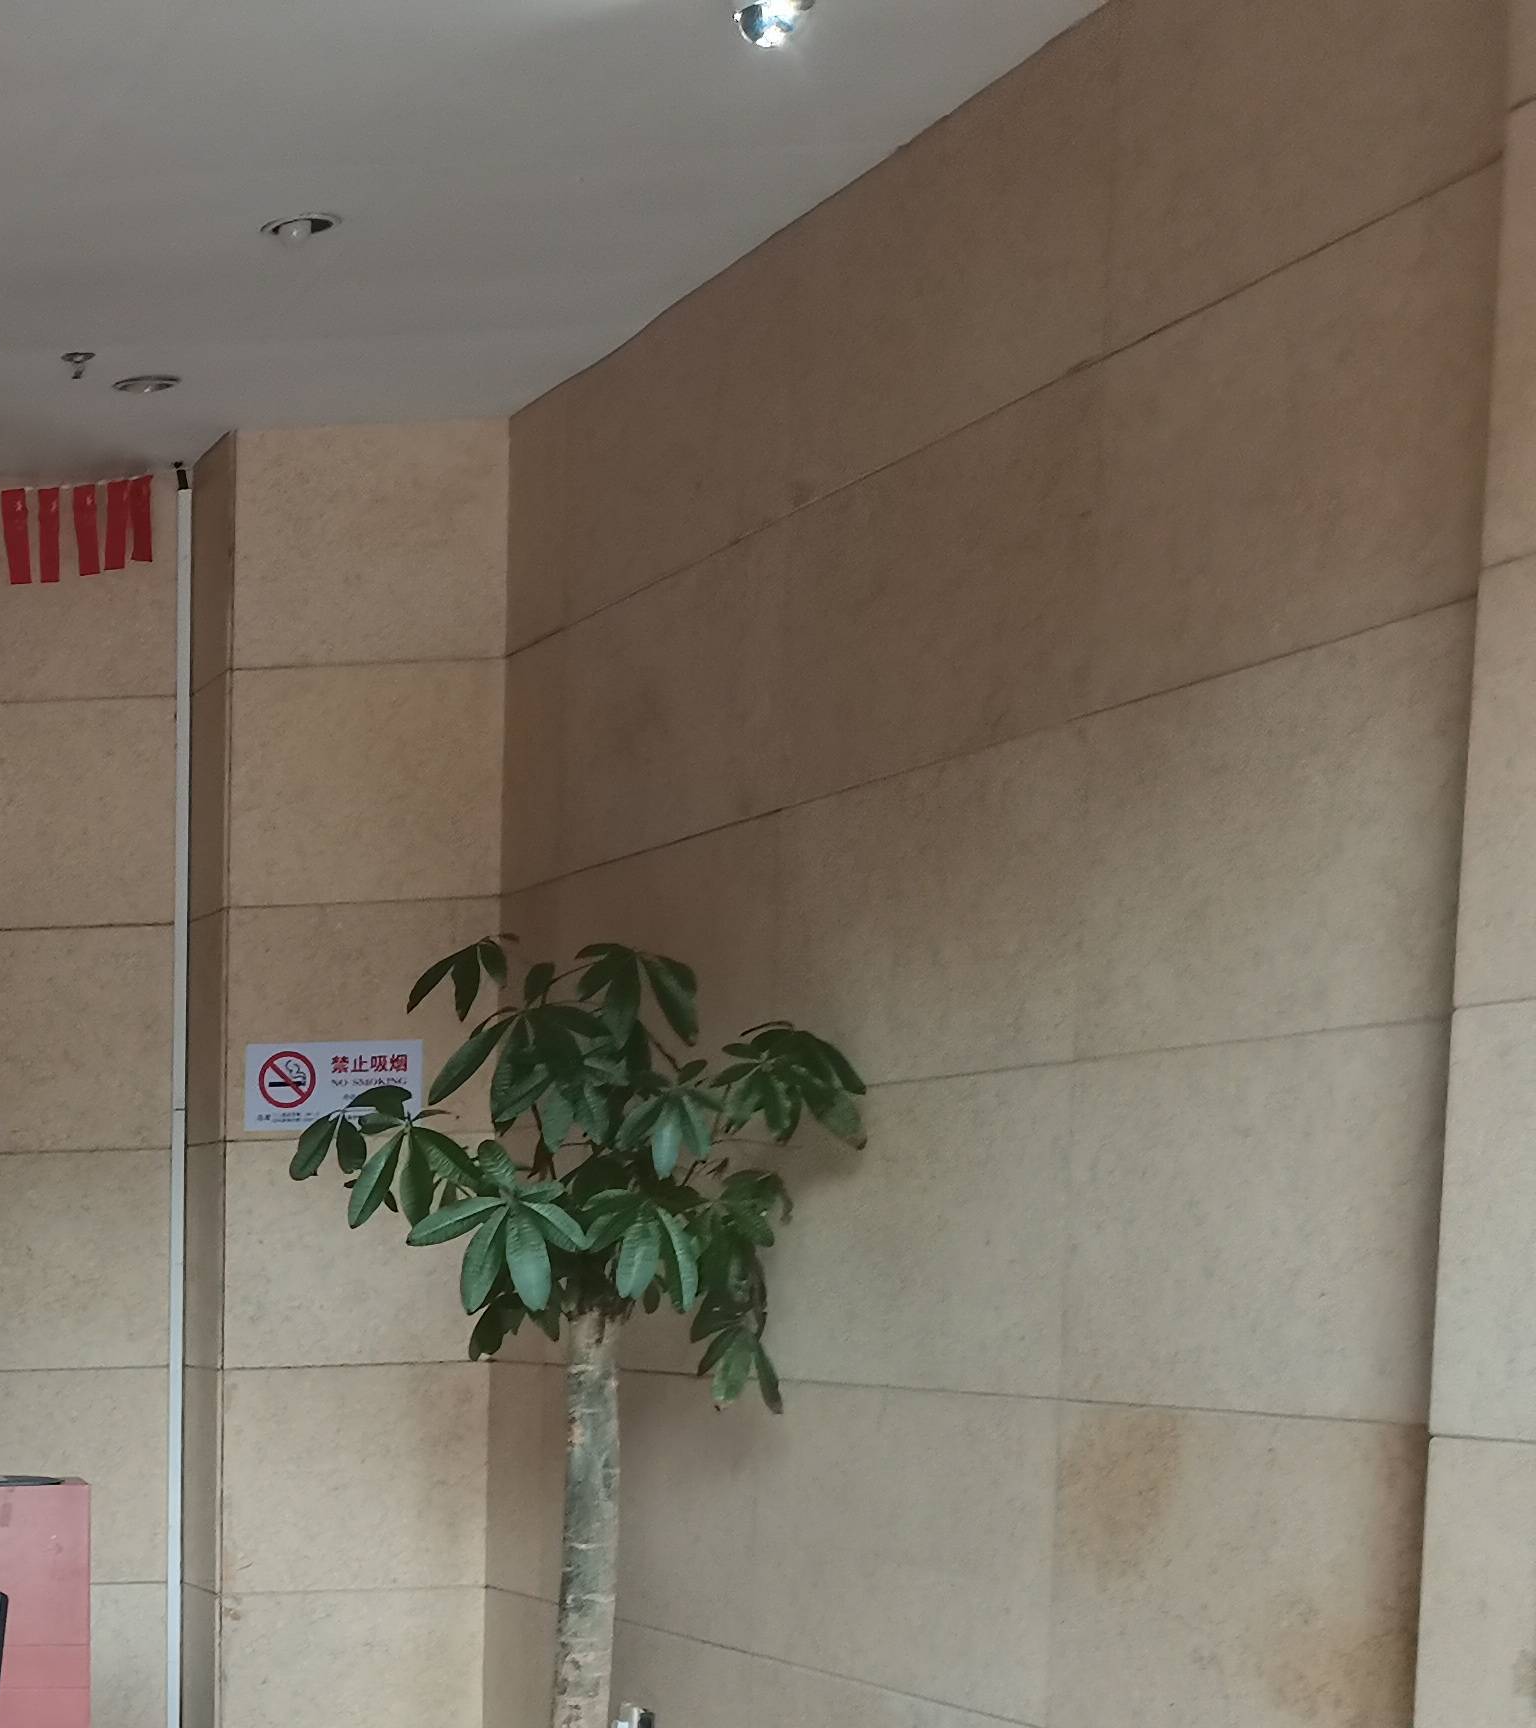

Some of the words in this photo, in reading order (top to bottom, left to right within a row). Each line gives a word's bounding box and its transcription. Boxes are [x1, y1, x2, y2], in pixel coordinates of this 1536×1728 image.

[330, 1054, 409, 1074] 禁止吸烟
[331, 1078, 348, 1087] NO
[351, 1076, 408, 1086] SMOKING
